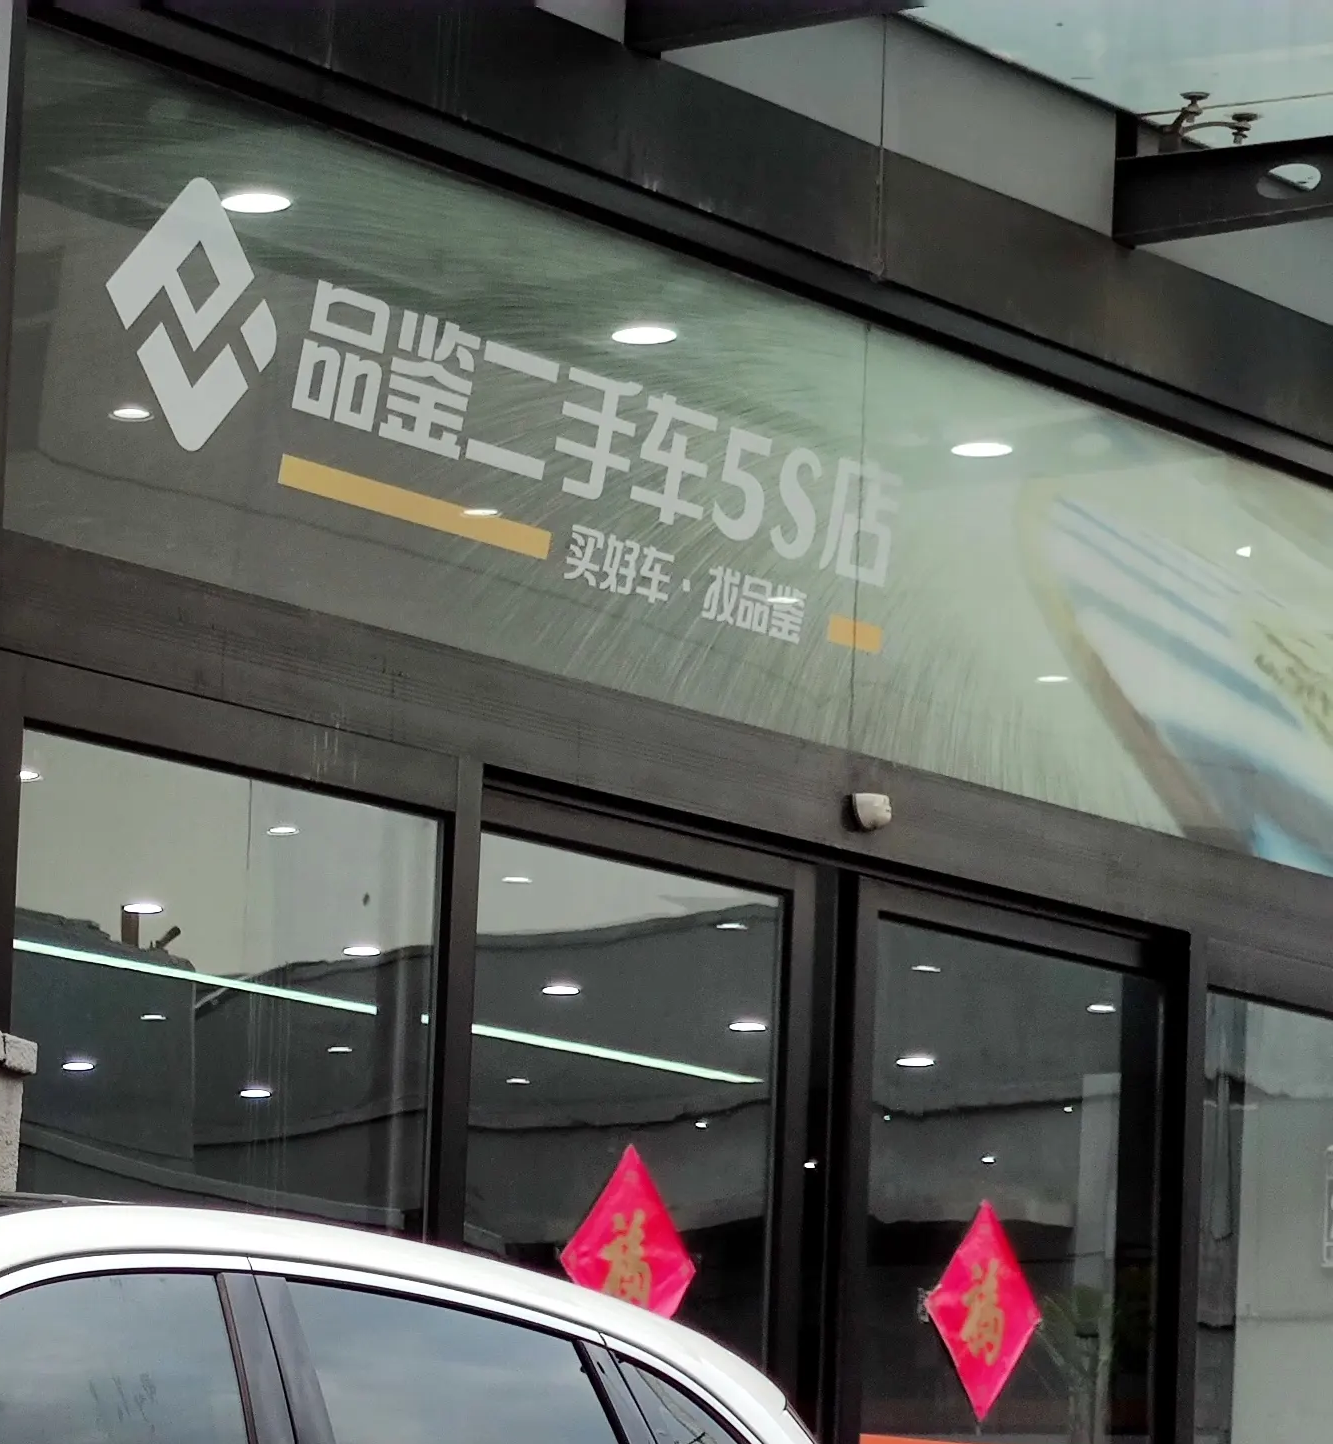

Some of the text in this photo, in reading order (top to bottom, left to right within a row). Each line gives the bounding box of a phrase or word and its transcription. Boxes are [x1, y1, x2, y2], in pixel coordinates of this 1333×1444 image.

[290, 279, 904, 588] 品鉴二手车5S店
